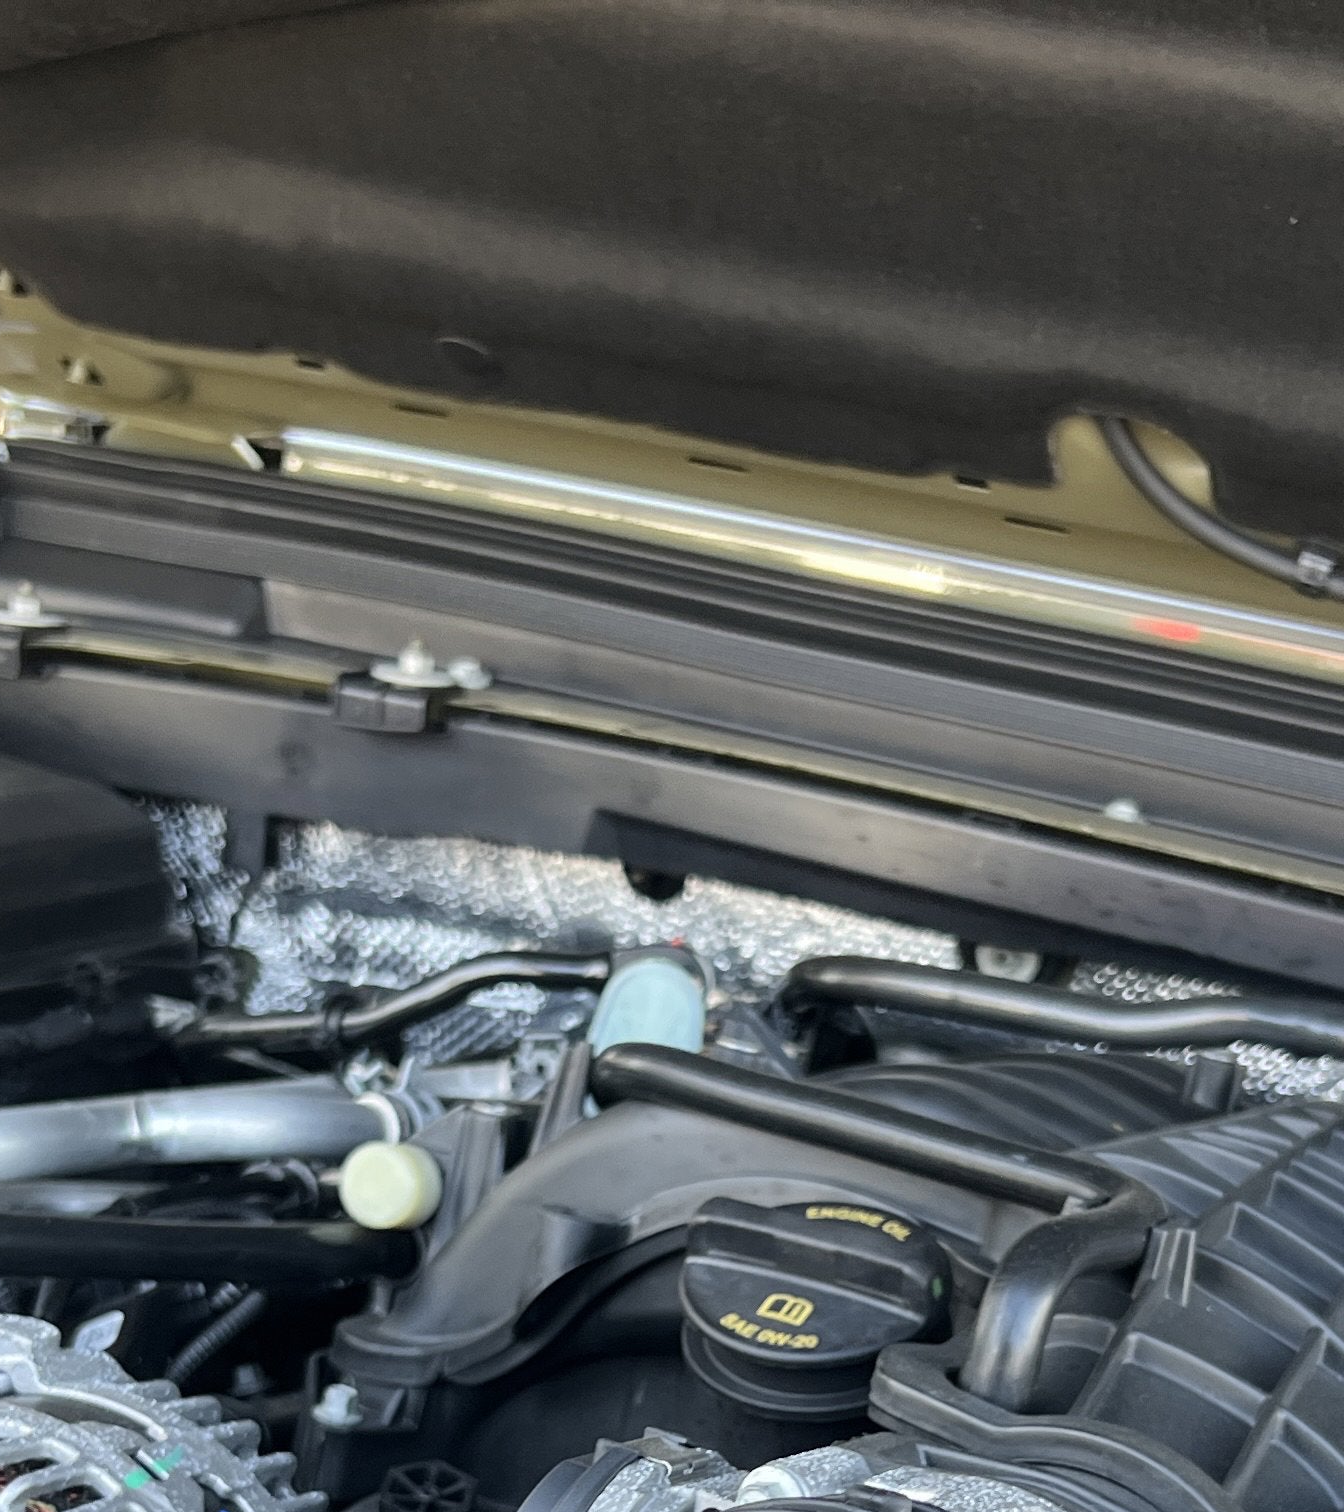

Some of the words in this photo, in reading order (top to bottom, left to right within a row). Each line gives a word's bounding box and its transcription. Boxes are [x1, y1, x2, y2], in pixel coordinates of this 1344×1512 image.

[806, 1205, 885, 1227] ENGINE
[882, 1220, 911, 1241] OIL
[720, 1312, 760, 1338] SAE
[757, 1329, 819, 1349] 0W-20
